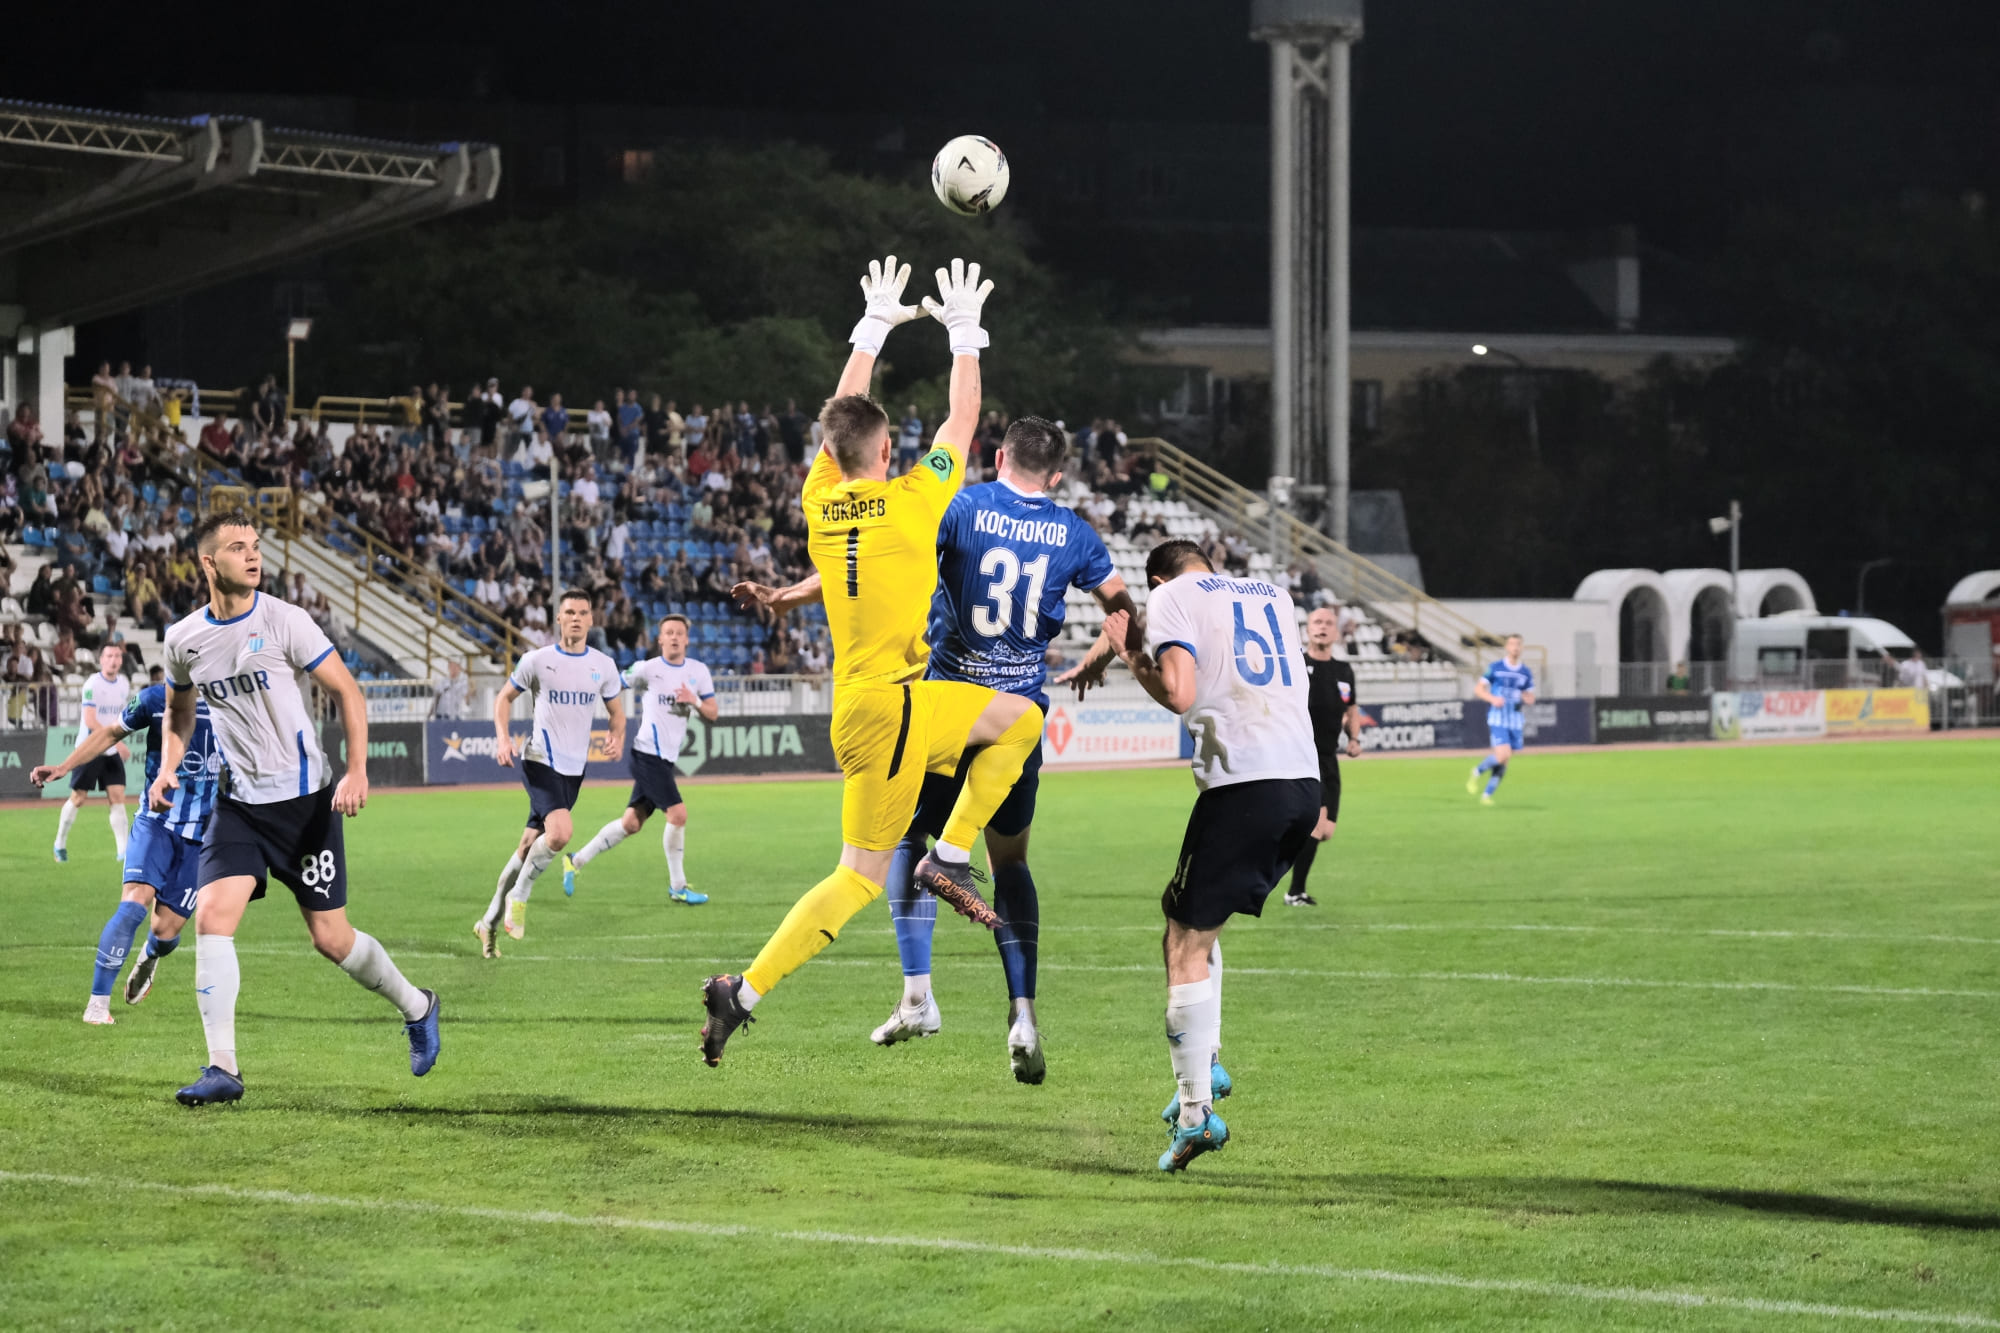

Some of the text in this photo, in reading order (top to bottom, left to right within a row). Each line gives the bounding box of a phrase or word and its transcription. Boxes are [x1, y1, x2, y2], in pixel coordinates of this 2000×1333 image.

[822, 498, 886, 522] КОКАРЕВ
[975, 510, 1068, 547] КОСТЮКОВ
[847, 527, 859, 597] 1
[972, 547, 1050, 639] 31
[1196, 578, 1277, 598] МАРТЫНОВ
[1233, 602, 1292, 687] 61
[711, 725, 804, 758] ЛИГА
[1077, 736, 1175, 753] ТЕЛЕВИДЕНИЕ
[301, 849, 336, 886] 88
[180, 887, 198, 911] 10
[110, 945, 125, 958] 10
